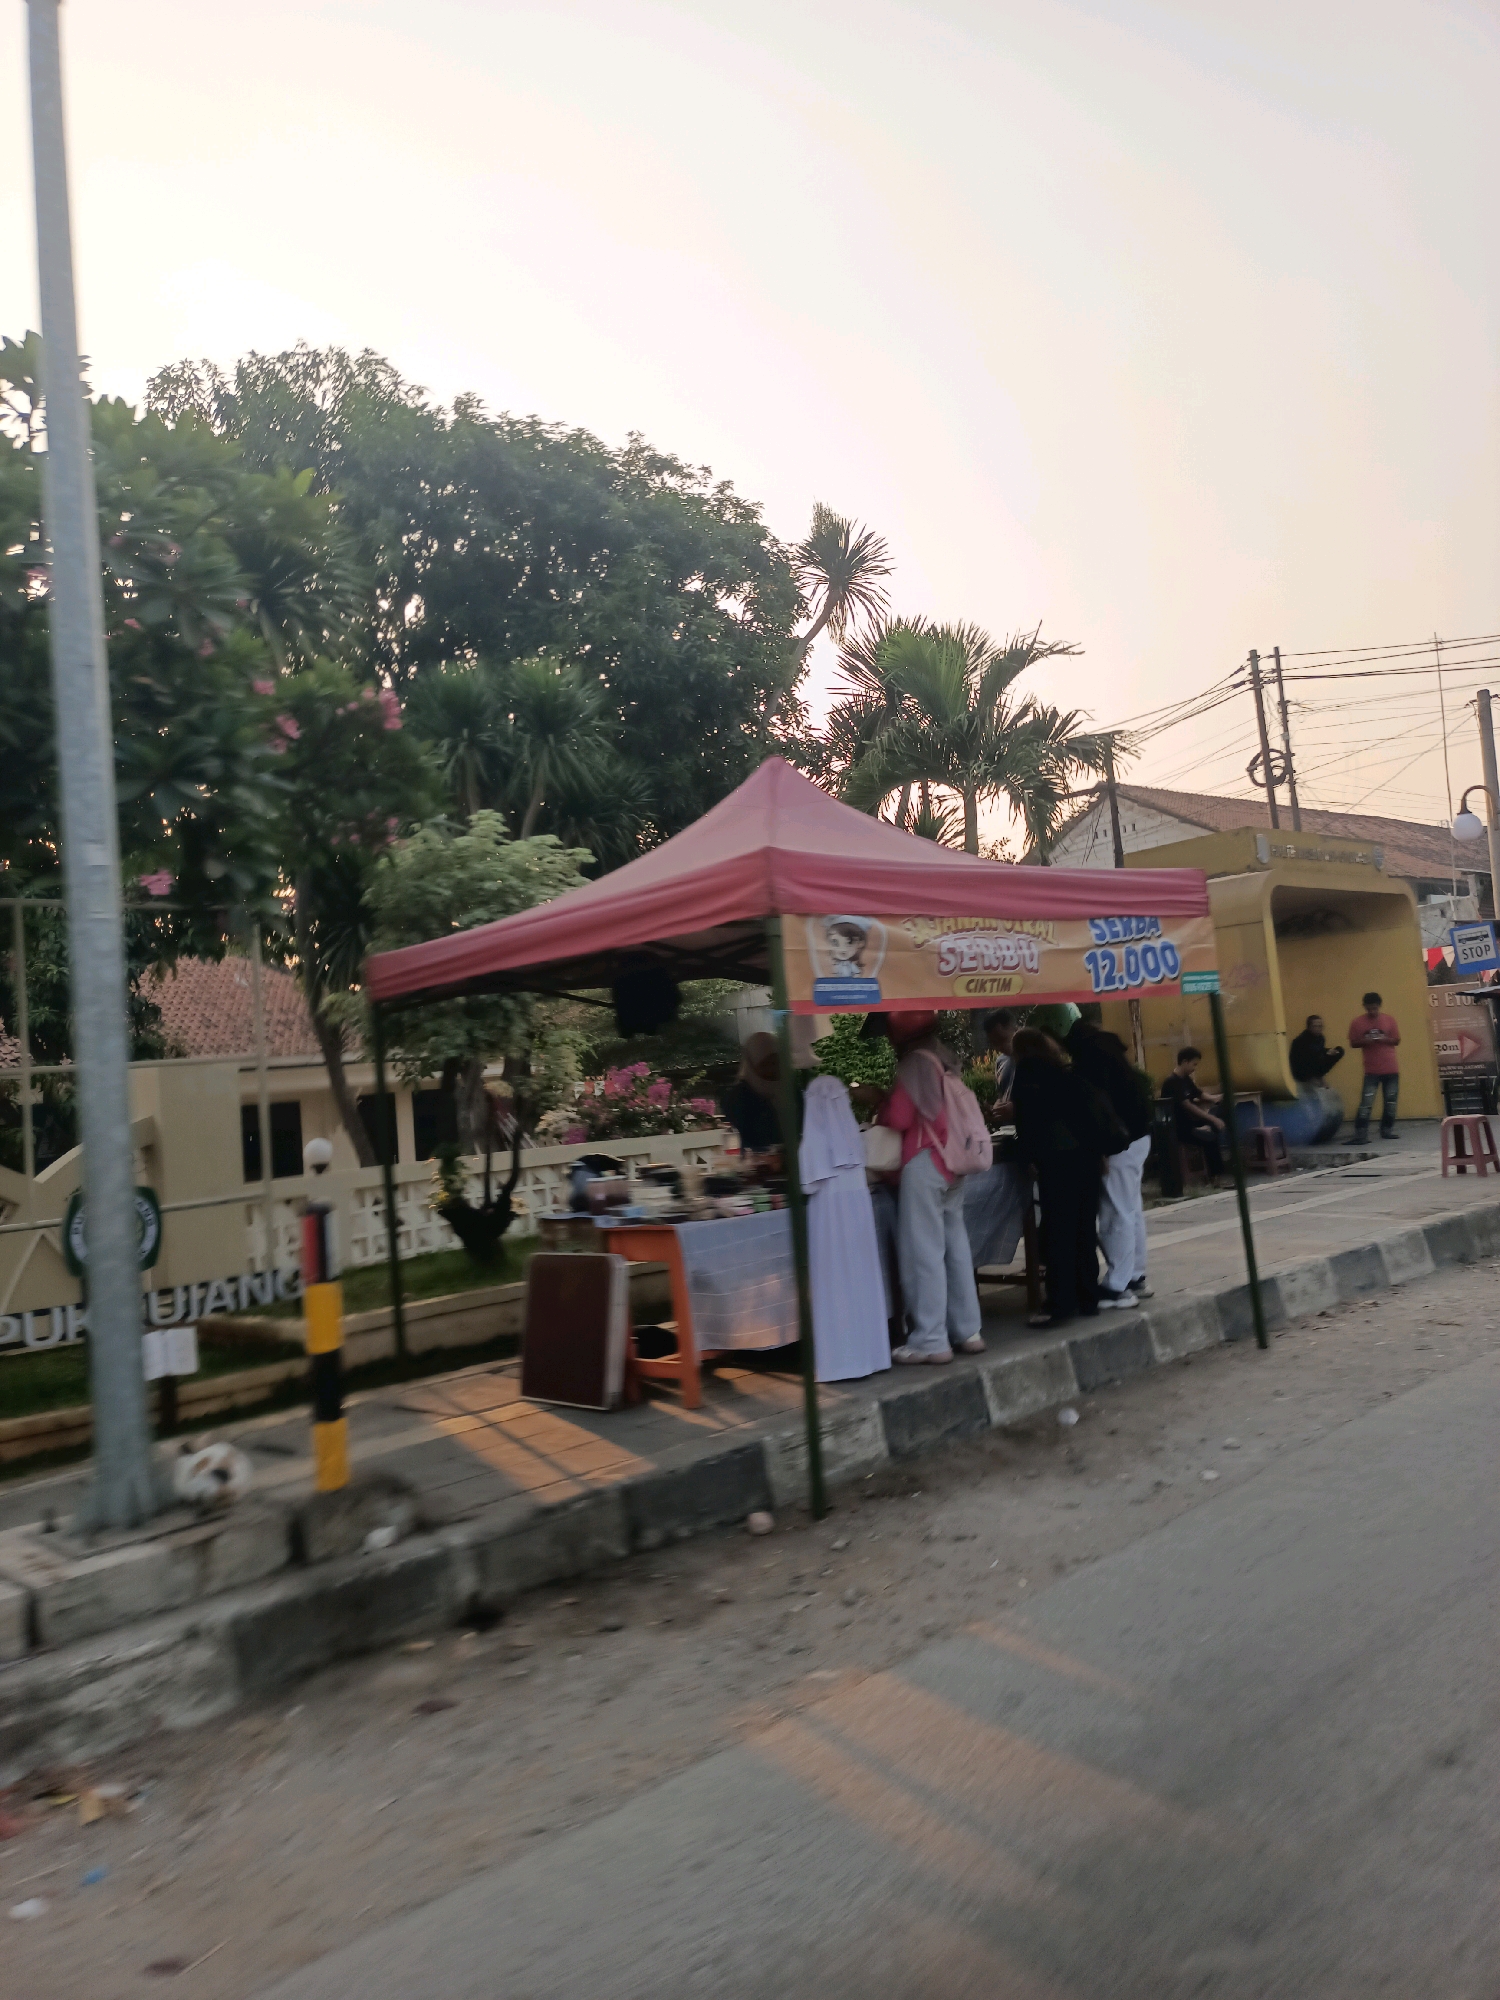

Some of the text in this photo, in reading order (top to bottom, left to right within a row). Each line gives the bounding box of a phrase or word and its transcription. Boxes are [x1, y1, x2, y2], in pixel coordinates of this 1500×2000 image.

[938, 936, 1040, 976] SERBU
[1084, 939, 1181, 993] 12.000
[1462, 944, 1491, 960] STOP
[966, 978, 1013, 994] CIKTIM
[150, 1268, 304, 1327] UJANG
